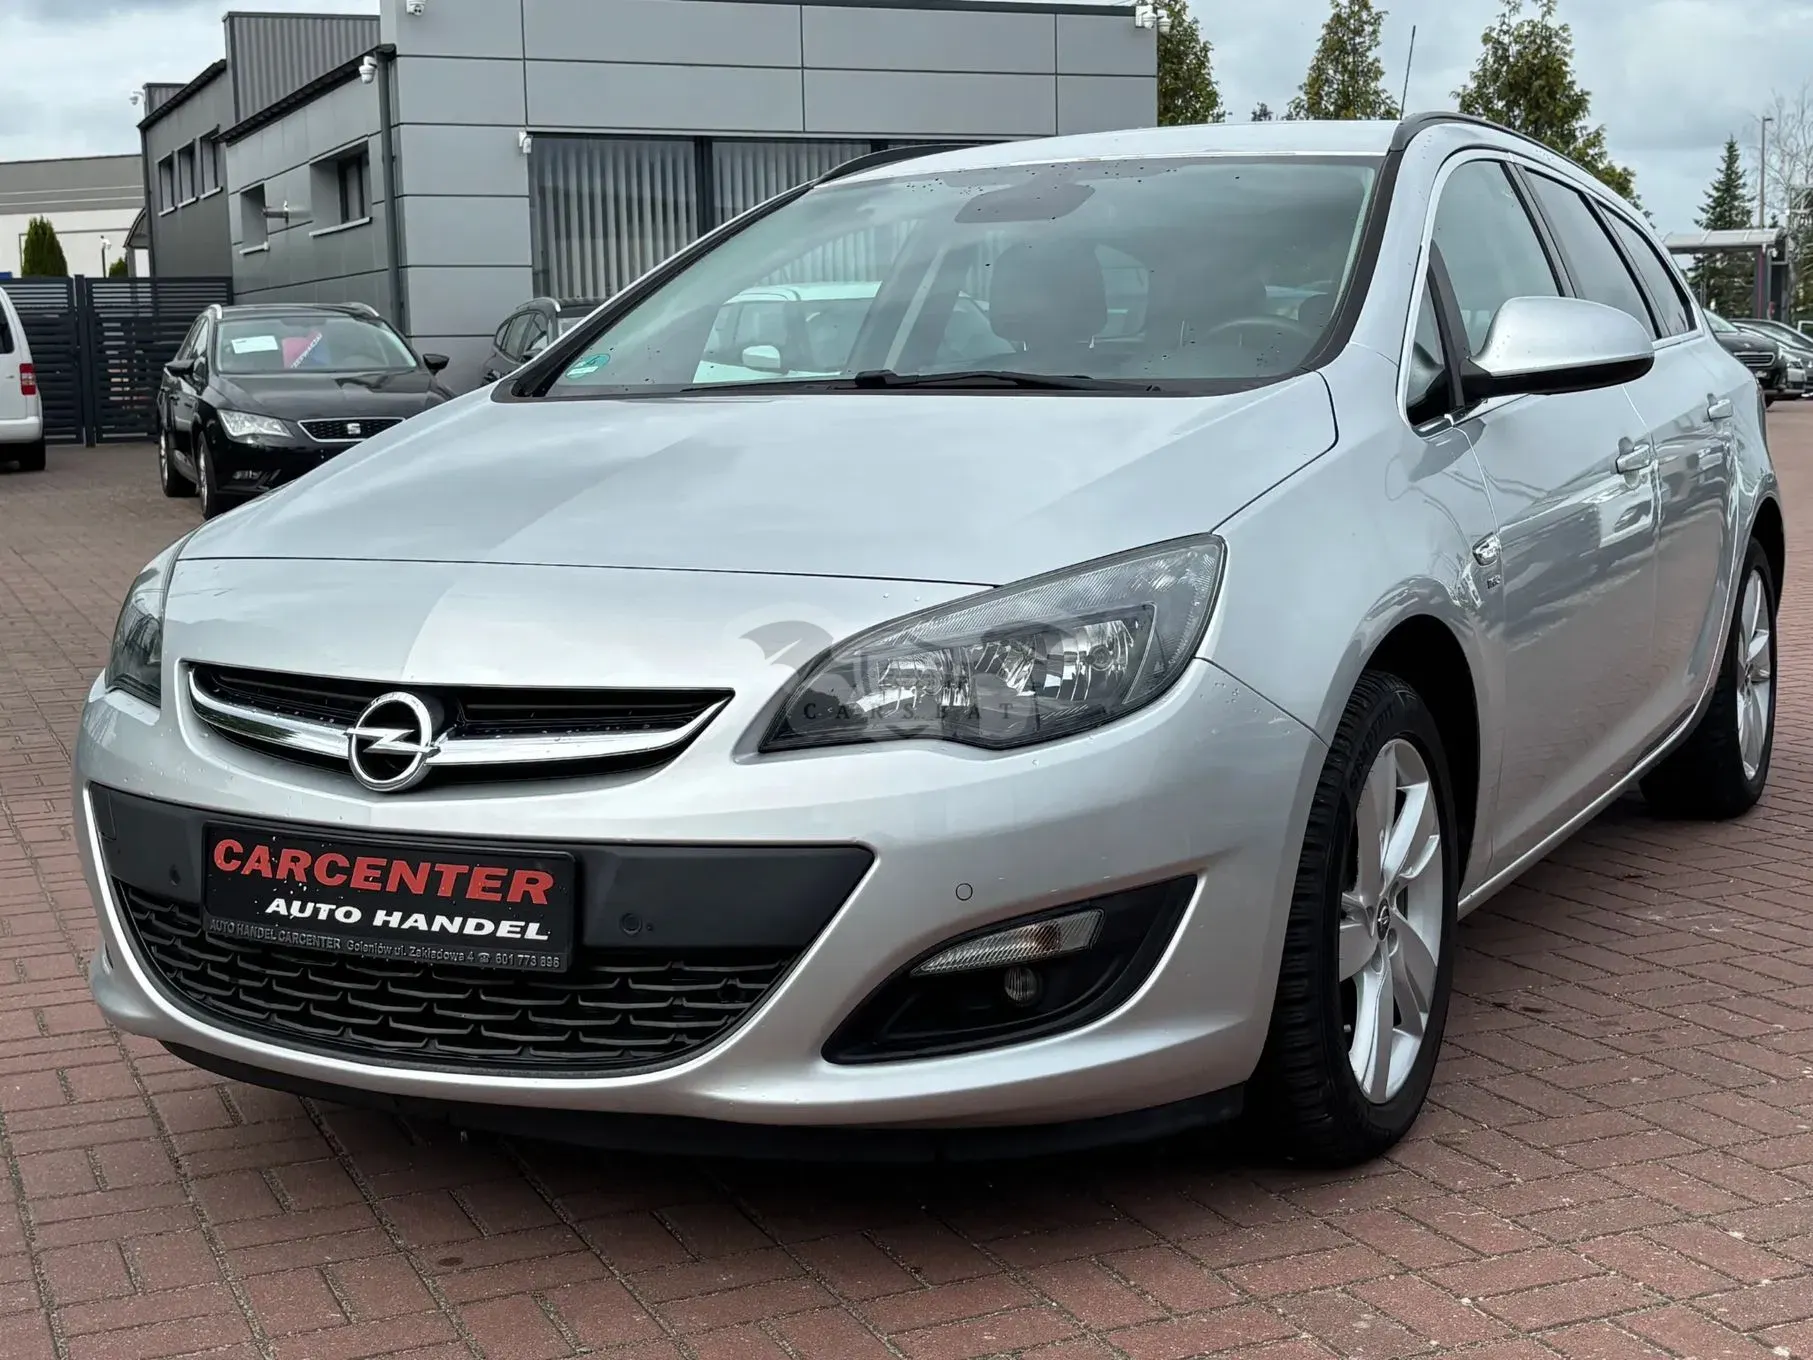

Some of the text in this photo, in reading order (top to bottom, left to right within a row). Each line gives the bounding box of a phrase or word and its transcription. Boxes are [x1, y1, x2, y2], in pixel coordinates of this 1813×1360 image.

[213, 839, 554, 904] CARCENTER
[210, 919, 235, 933] AUTO
[237, 923, 277, 940] HANDEL
[279, 930, 340, 949] CARCENTER
[496, 953, 513, 965] 601
[517, 954, 536, 966] 773
[265, 898, 549, 942] AUTO HANDEL
